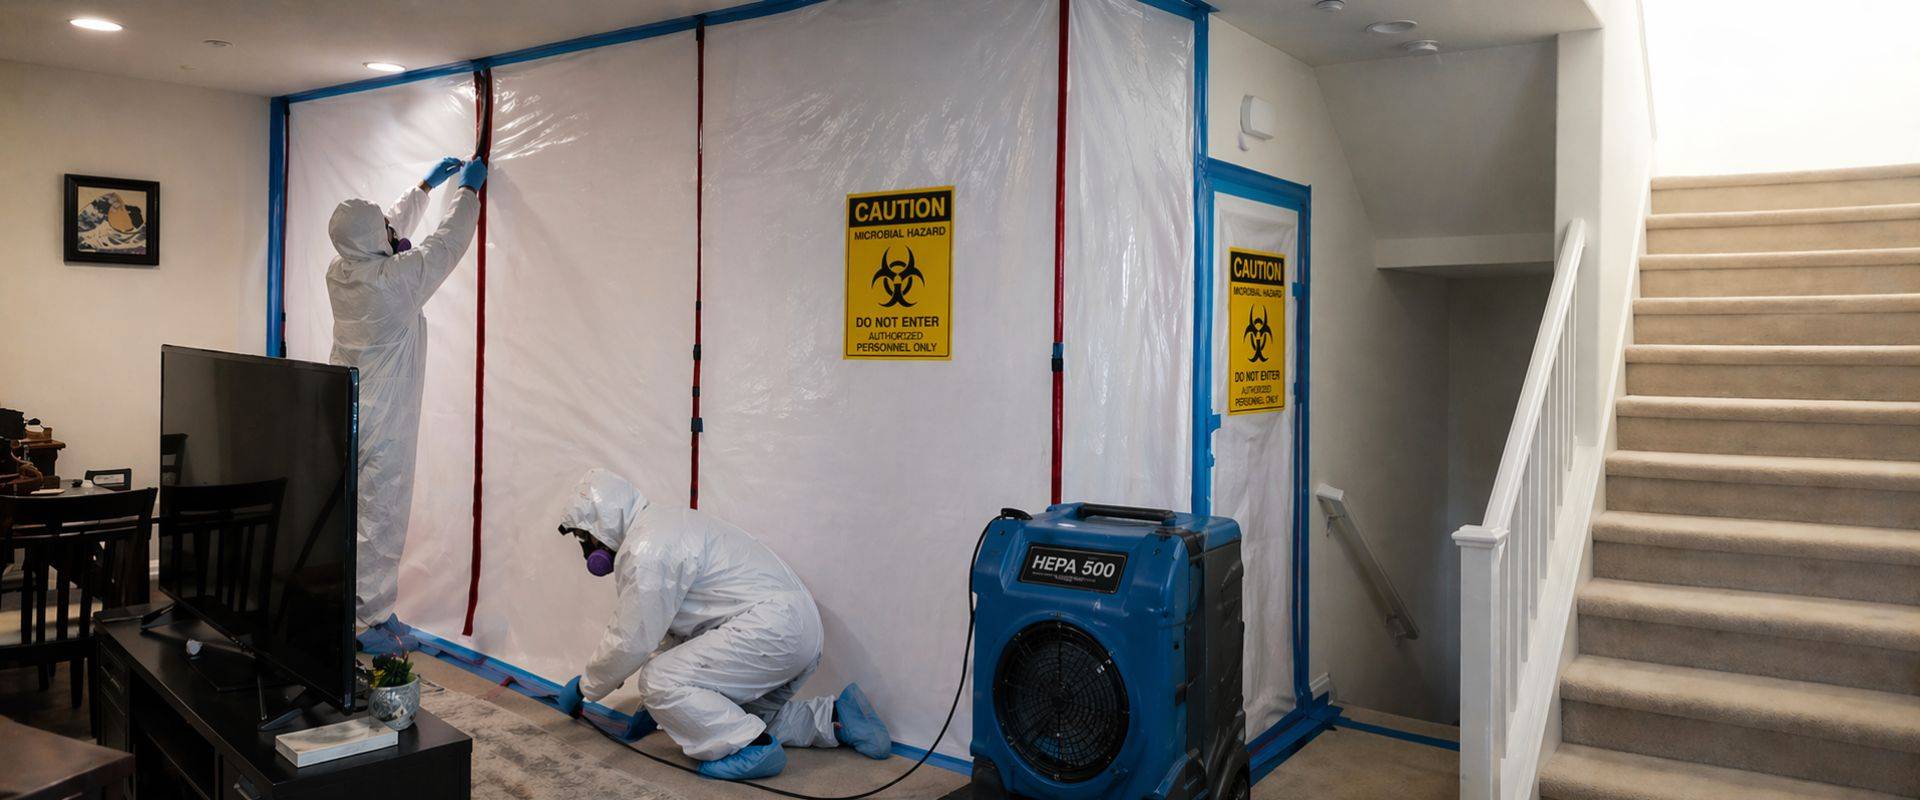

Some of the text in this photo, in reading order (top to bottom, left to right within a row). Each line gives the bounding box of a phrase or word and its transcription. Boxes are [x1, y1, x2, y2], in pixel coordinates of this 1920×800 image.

[855, 197, 945, 222] CAUTION
[855, 226, 946, 240] MICROBIAL HAZARD
[1234, 257, 1281, 281] CAUTION
[856, 316, 940, 328] DO NOT ENTER
[868, 331, 923, 341] AUTHORIZED
[856, 342, 938, 352] PERSONNEL ONLY
[1235, 371, 1245, 382] DO
[1246, 370, 1259, 381] NOT
[1032, 555, 1076, 574] HEPA
[1081, 560, 1116, 578] 500
